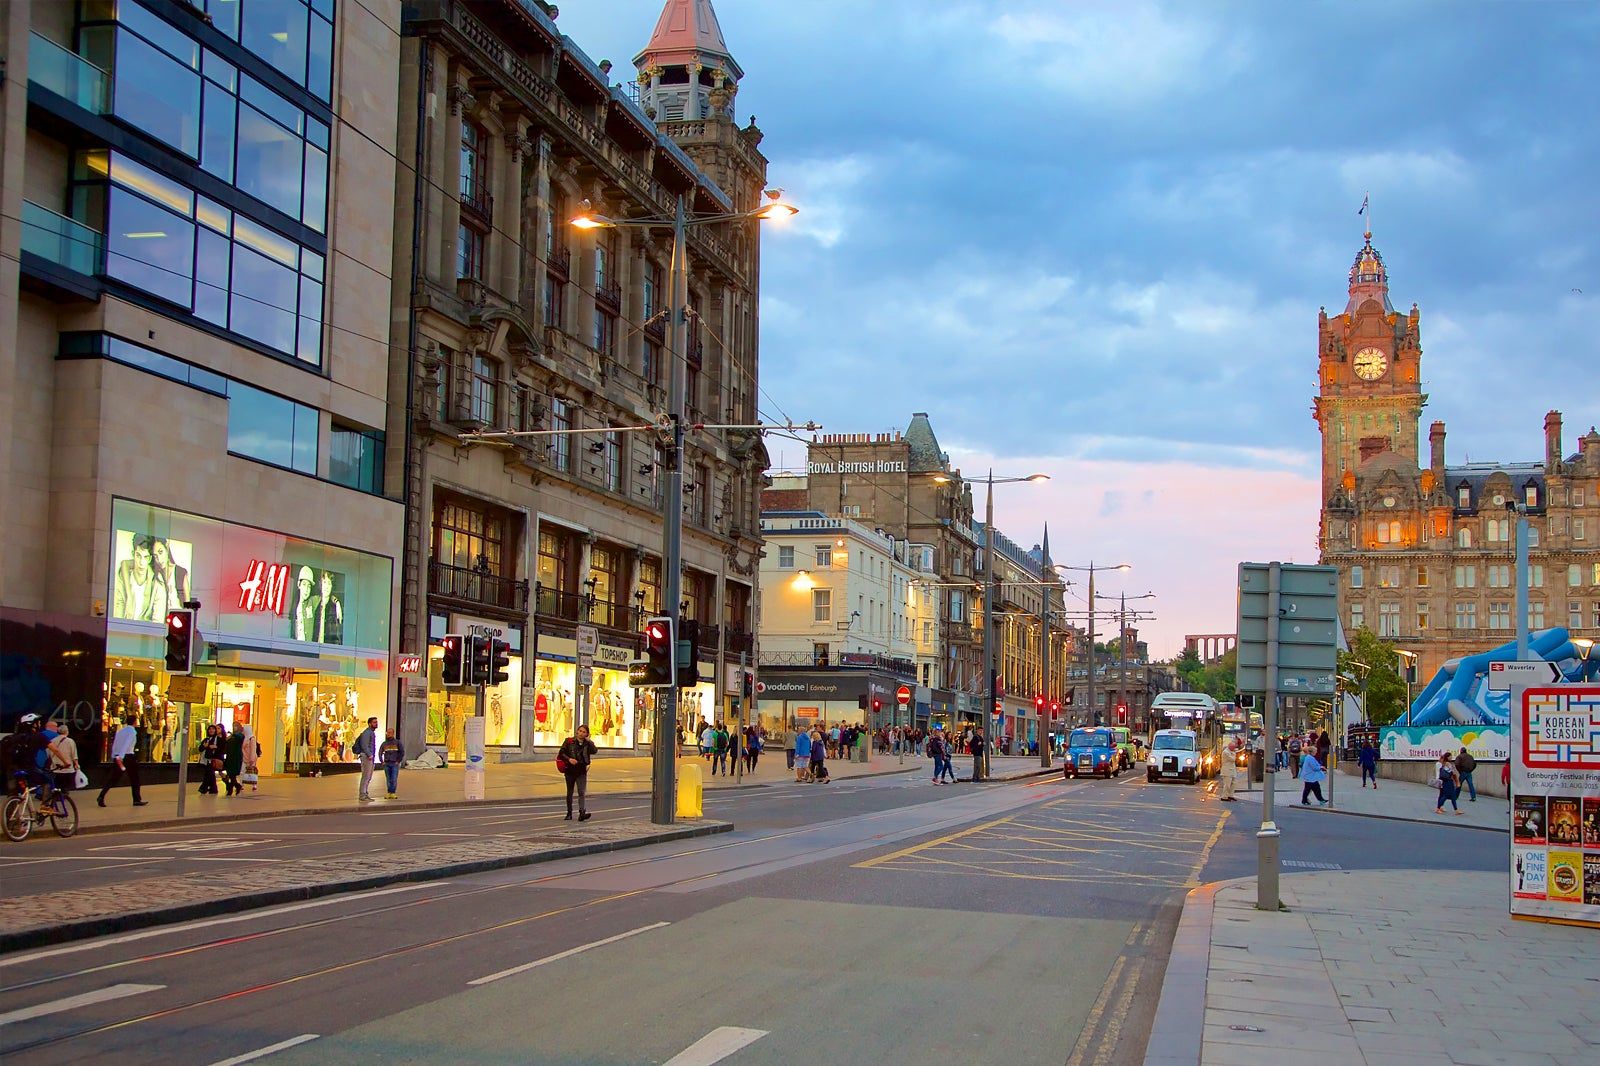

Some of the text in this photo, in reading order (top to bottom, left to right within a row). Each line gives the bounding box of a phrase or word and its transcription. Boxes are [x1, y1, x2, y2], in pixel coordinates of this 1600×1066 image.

[238, 559, 290, 616] H&M
[601, 648, 628, 662] TOPSHOP
[767, 683, 805, 691] vodafone
[48, 700, 95, 731] 40
[1545, 717, 1585, 728] KOREAN
[1545, 728, 1585, 739] SEASON
[1409, 749, 1426, 757] Street
[1428, 748, 1442, 757] Food
[1494, 749, 1506, 757] Bar
[1527, 772, 1558, 780] Edinburgh
[1526, 852, 1545, 862] ONE
[1526, 862, 1545, 872] FINE
[1526, 873, 1545, 882] DAY
